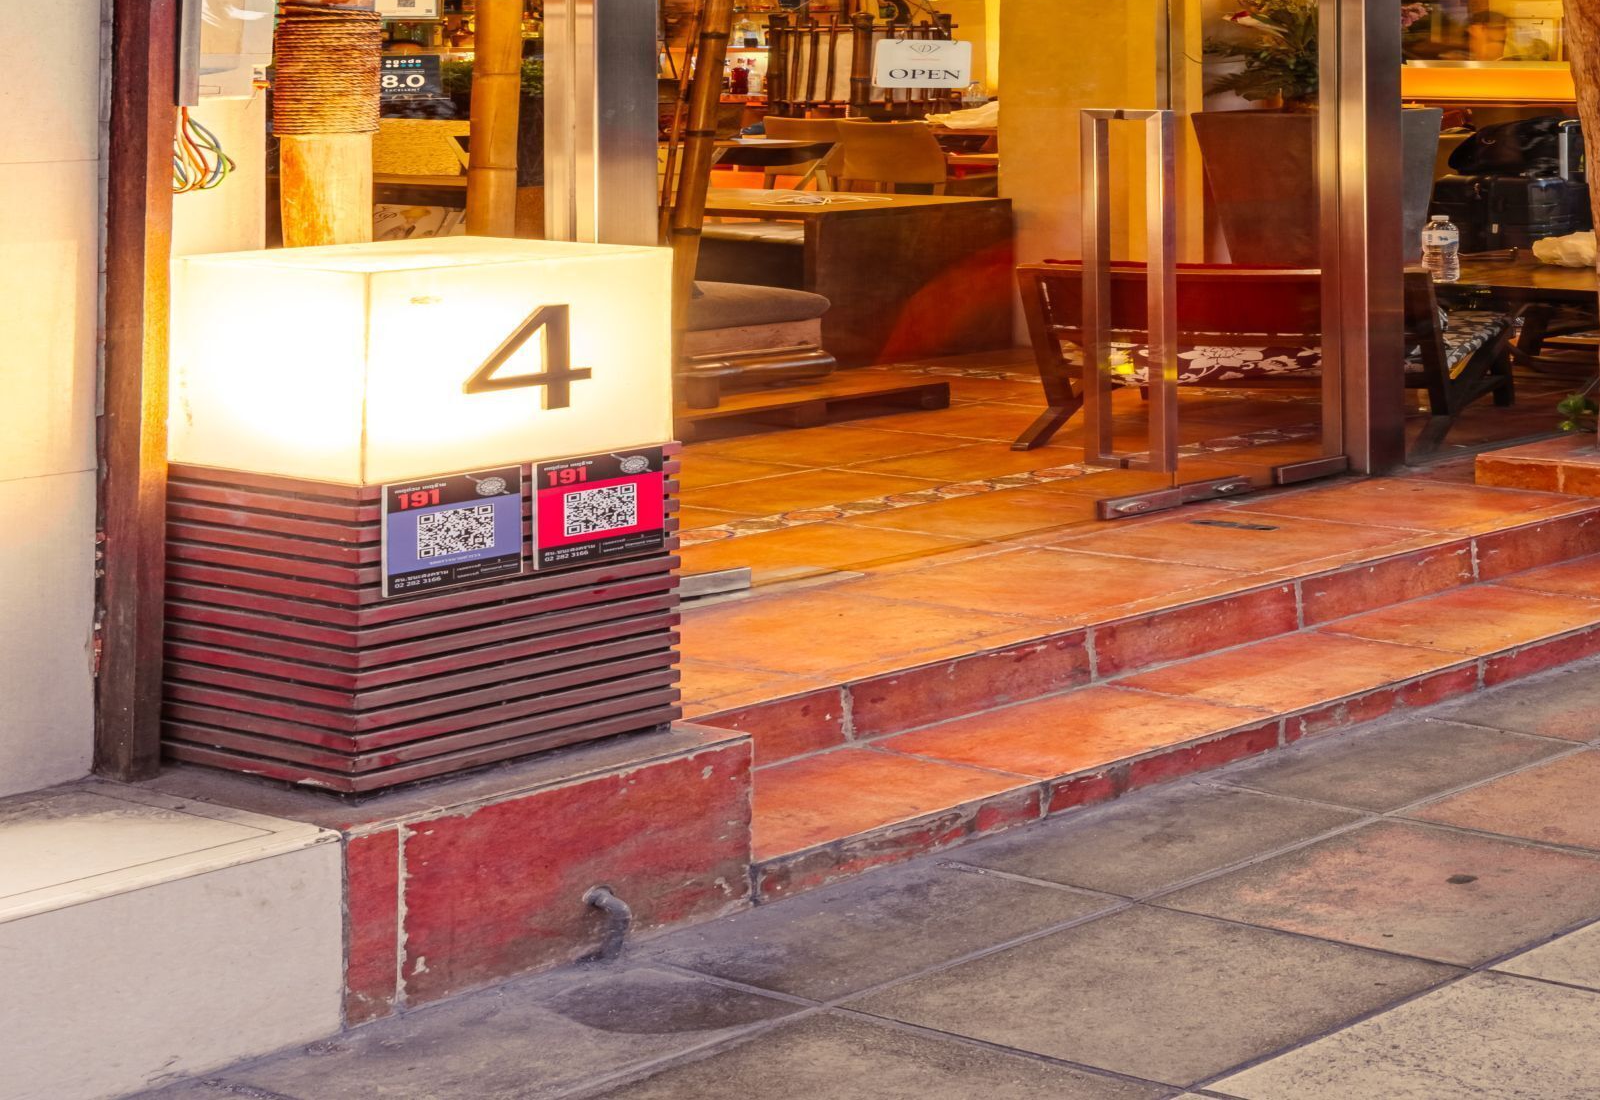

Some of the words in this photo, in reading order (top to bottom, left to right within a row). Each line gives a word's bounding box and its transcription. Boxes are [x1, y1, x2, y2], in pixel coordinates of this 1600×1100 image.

[381, 74, 425, 88] 8.0
[889, 69, 959, 80] OPEN
[463, 304, 592, 411] 4
[547, 466, 587, 487] 191
[398, 488, 440, 510] 191
[422, 575, 442, 584] 3166
